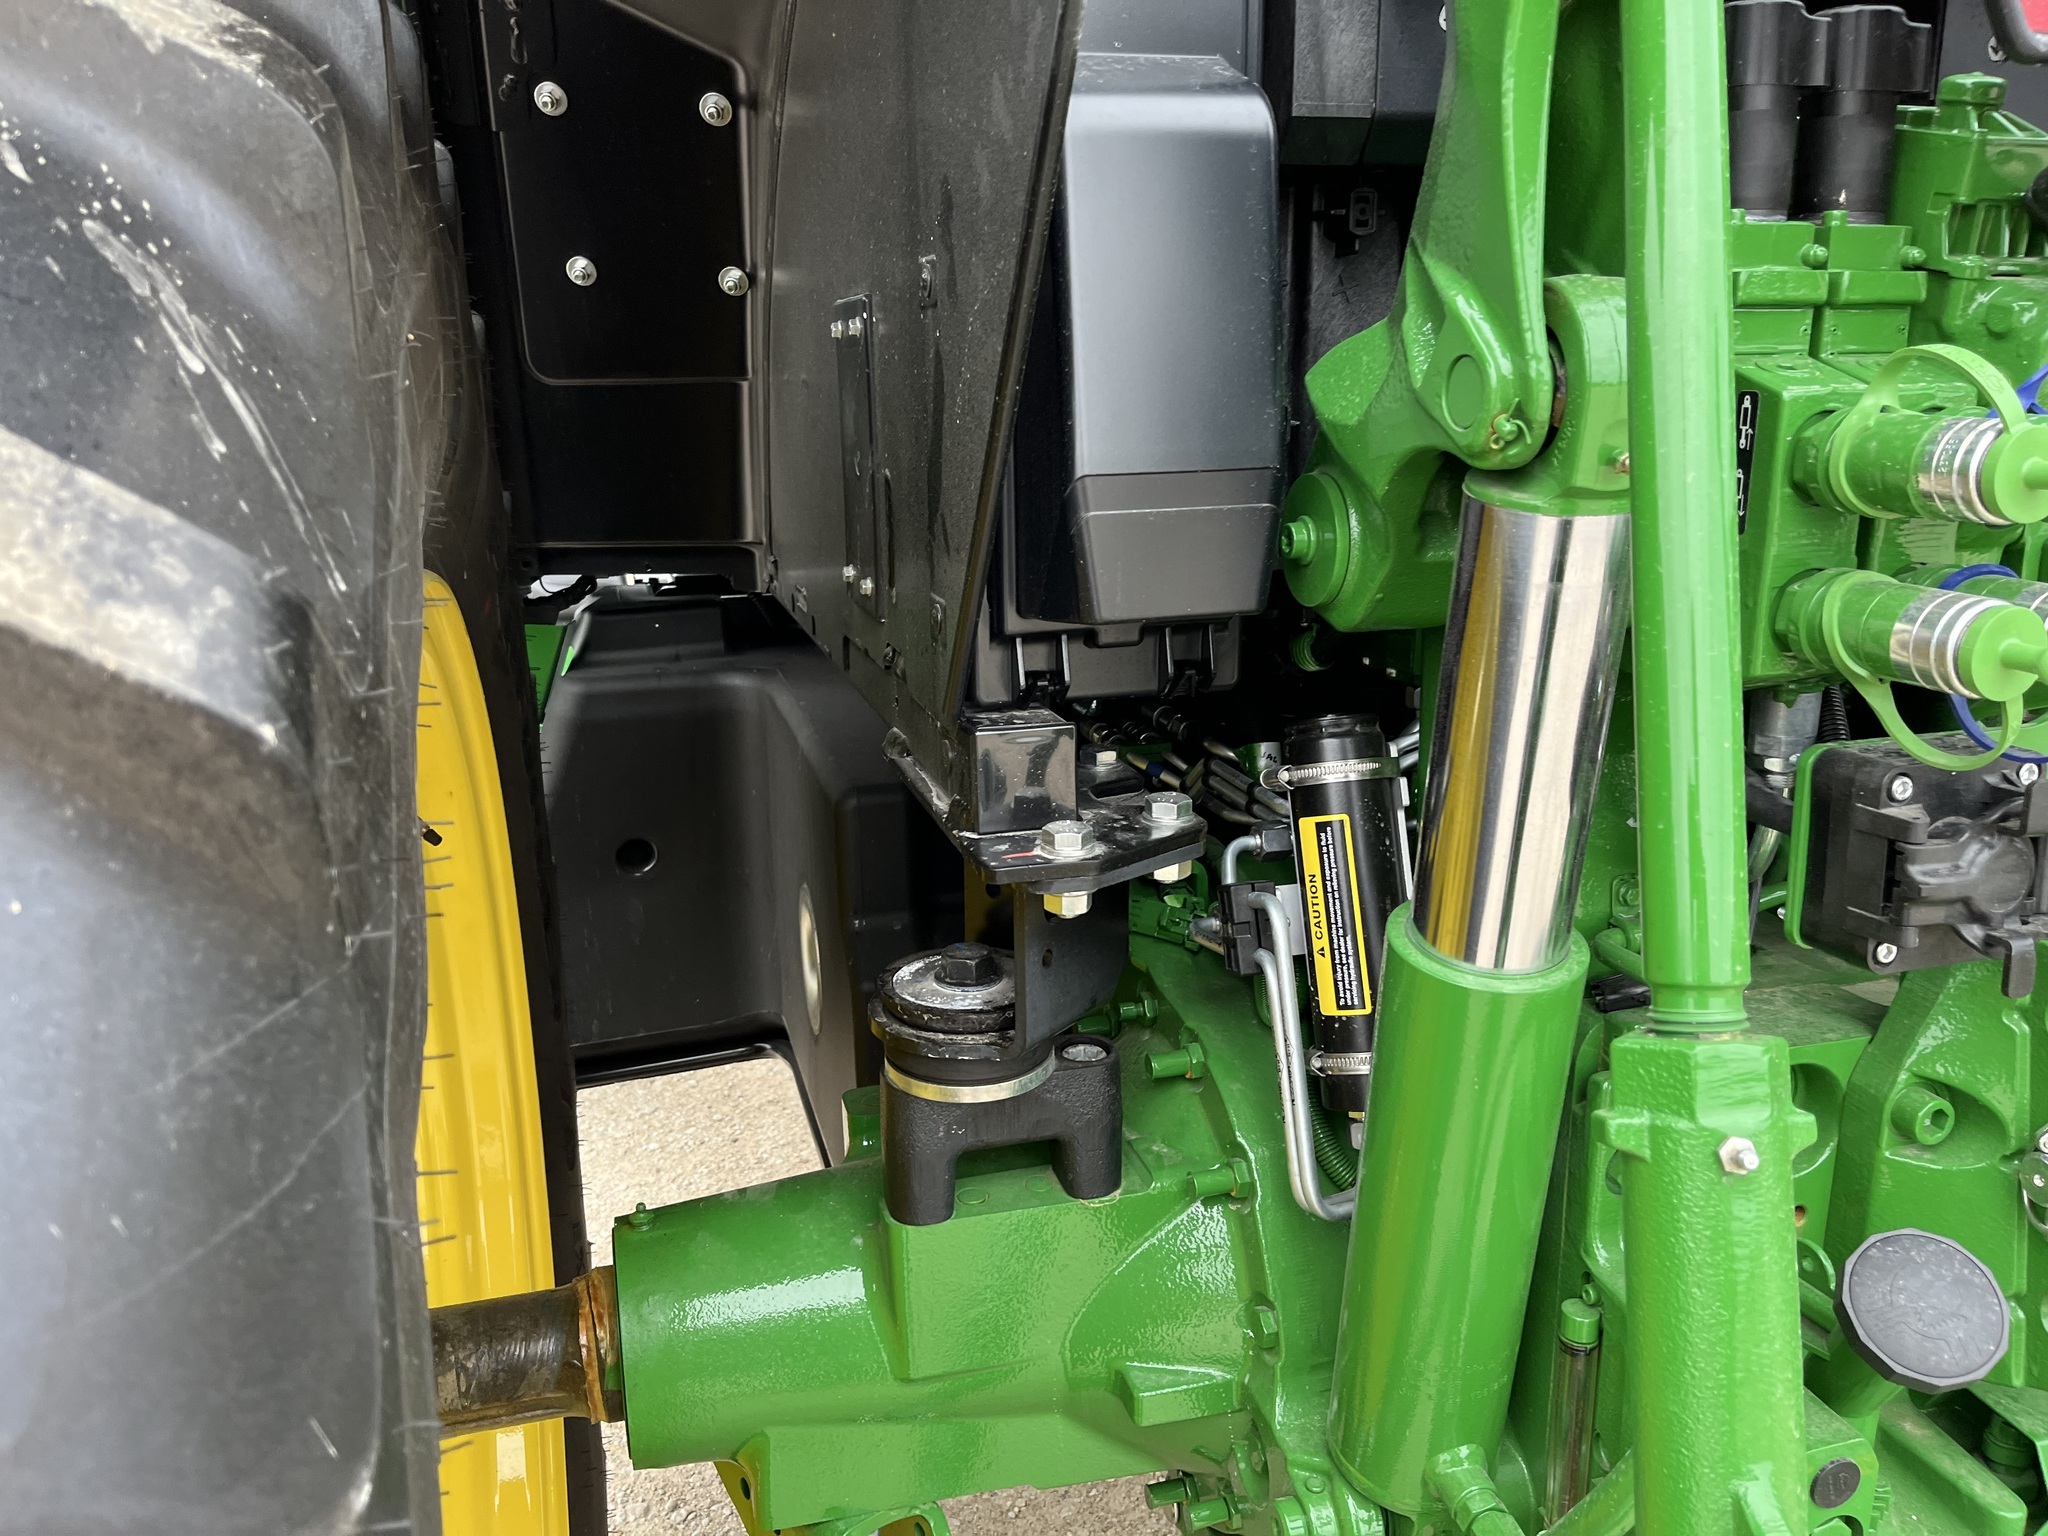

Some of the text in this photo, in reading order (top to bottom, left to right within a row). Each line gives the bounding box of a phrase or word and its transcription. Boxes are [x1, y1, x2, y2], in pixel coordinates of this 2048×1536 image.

[1309, 875, 1323, 939] CAUTION
[1327, 893, 1335, 923] movement
[1348, 956, 1356, 980] hydraulic
